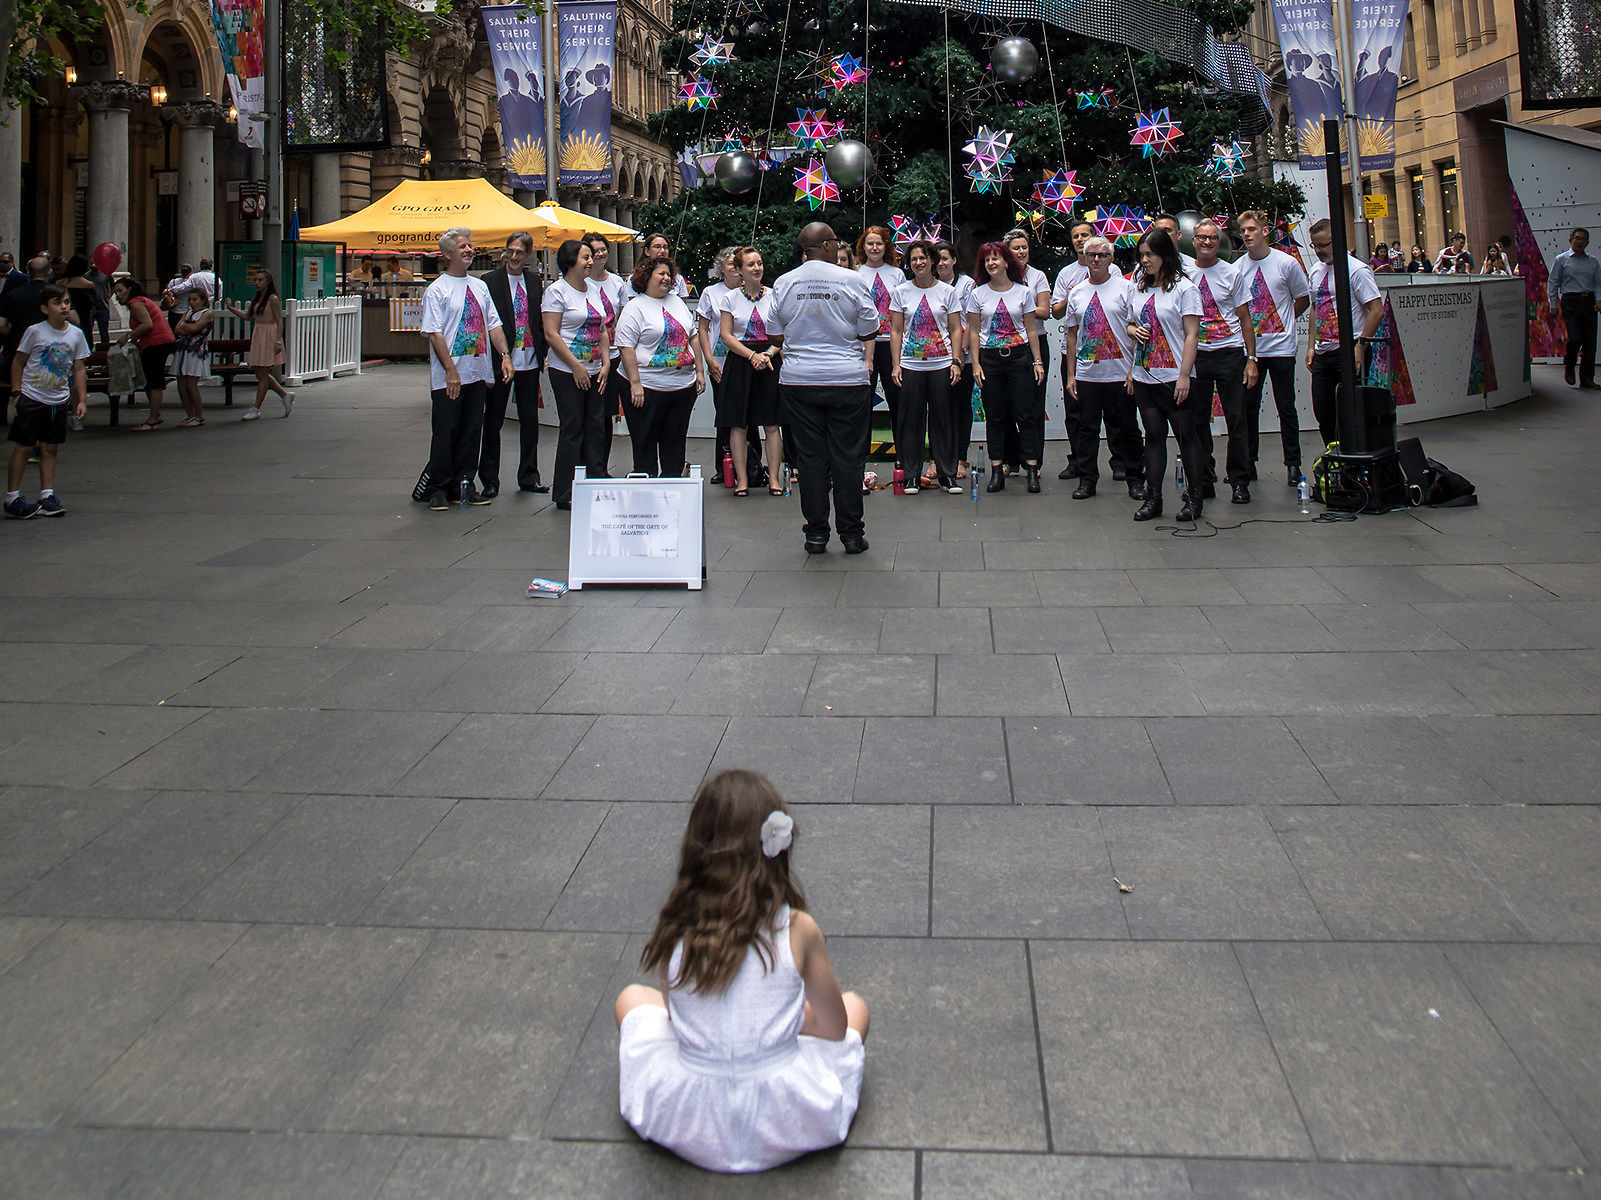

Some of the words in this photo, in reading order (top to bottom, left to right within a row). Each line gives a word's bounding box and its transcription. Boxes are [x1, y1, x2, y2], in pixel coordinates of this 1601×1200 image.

[563, 12, 612, 21] SALUTING
[500, 29, 531, 39] THEIR
[573, 24, 605, 34] THEIR
[496, 41, 538, 52] SERVICE
[566, 37, 611, 47] SERVICE
[423, 204, 471, 212] GRAND
[377, 231, 442, 244] gpogrand.c
[1399, 294, 1427, 308] HAPPY
[1428, 292, 1473, 306] CHRISTMAS
[1417, 312, 1430, 320] CITY
[1430, 312, 1437, 320] OF
[1438, 310, 1458, 319] SYDNEY
